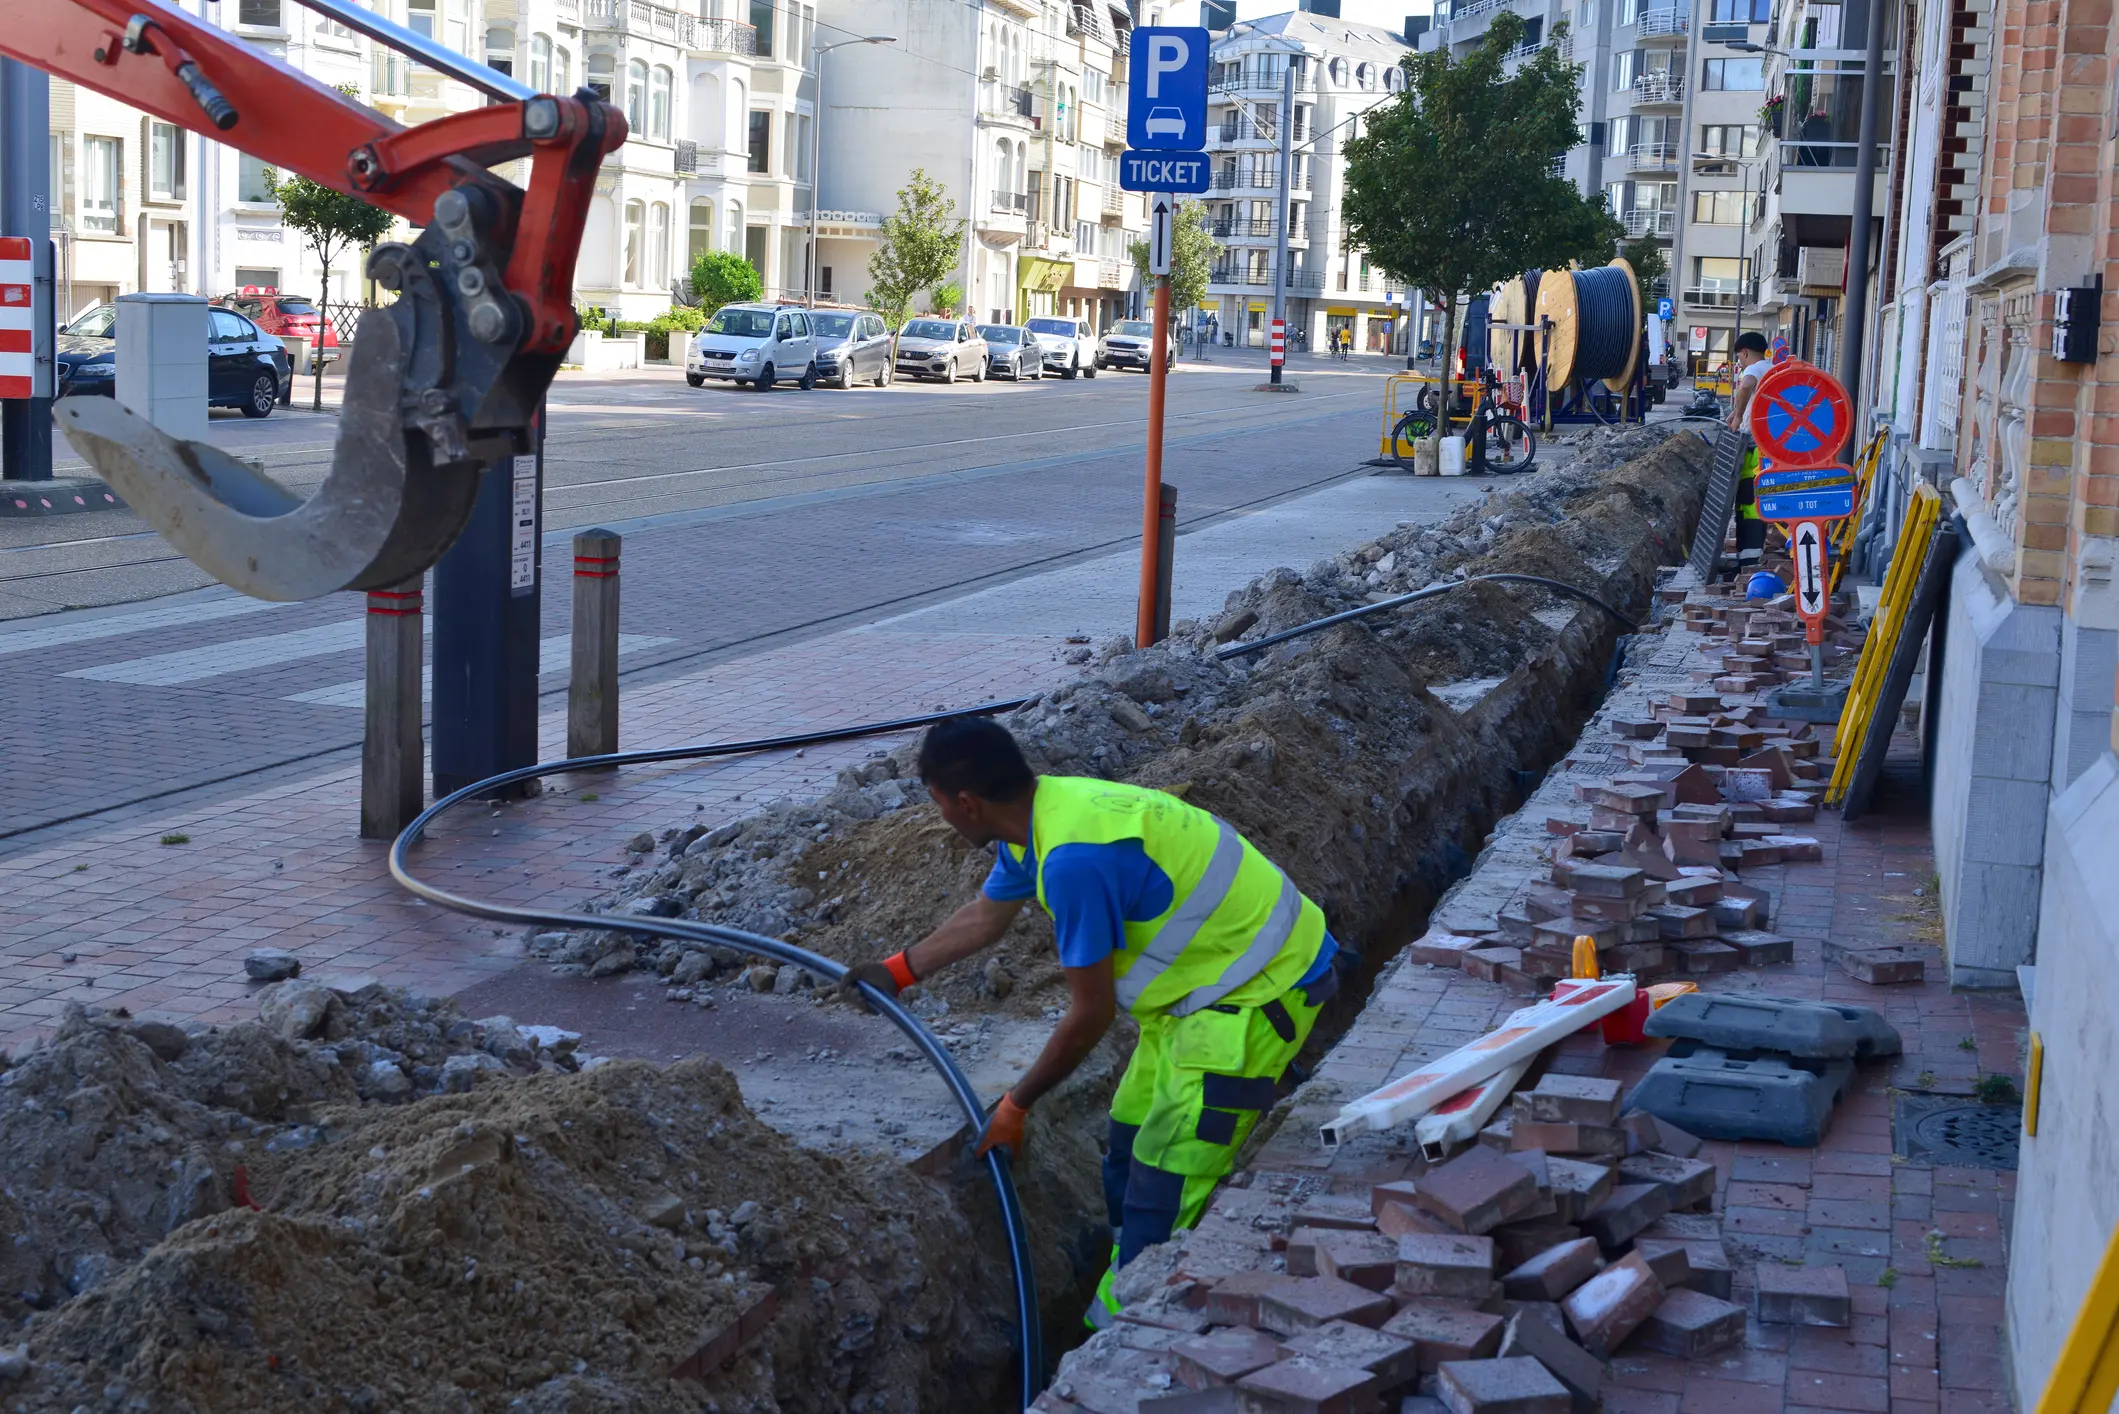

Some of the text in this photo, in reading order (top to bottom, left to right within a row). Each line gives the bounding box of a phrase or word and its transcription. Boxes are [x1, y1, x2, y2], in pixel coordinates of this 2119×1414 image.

[1146, 35, 1190, 98] P
[1128, 160, 1201, 184] TICKET
[1660, 302, 1670, 316] P
[1763, 503, 1776, 512] VAN
[1805, 500, 1818, 509] TOT
[1844, 499, 1850, 508] U
